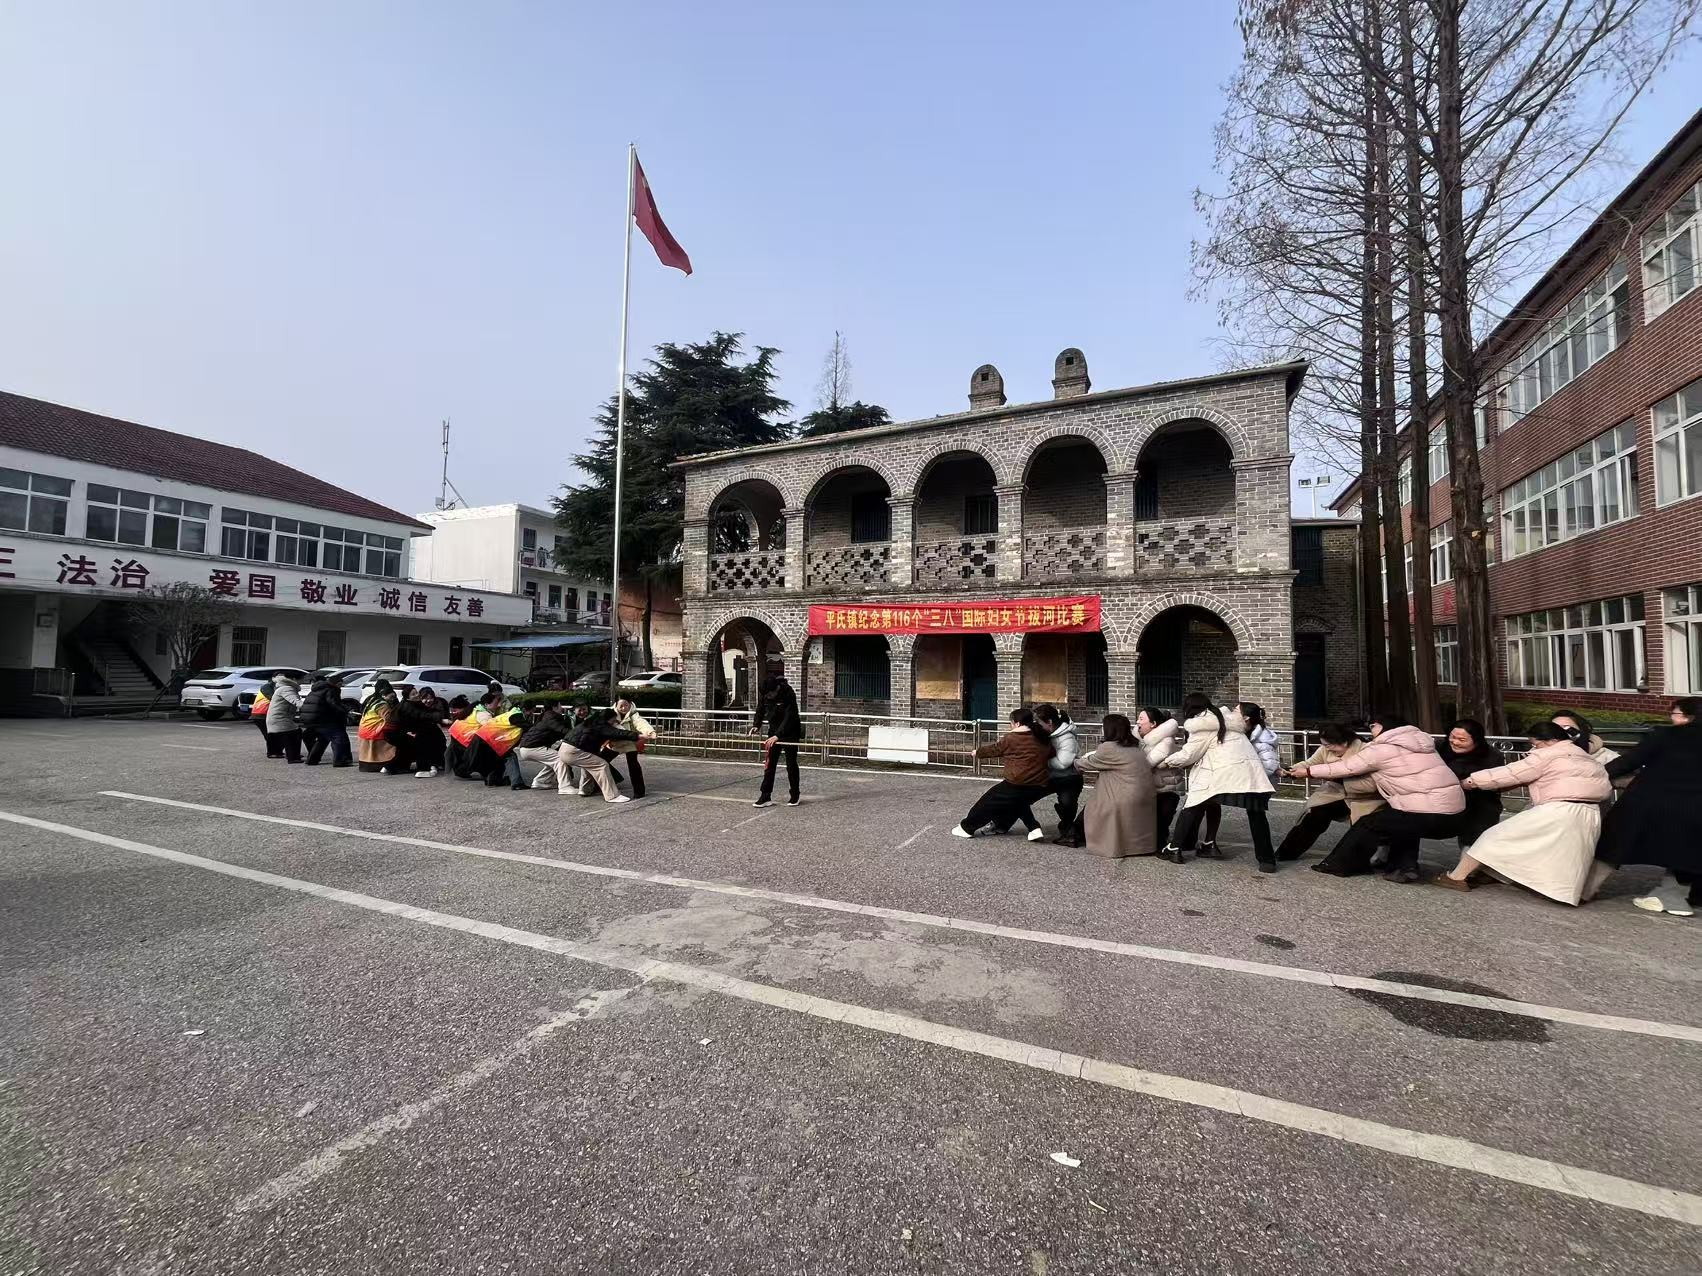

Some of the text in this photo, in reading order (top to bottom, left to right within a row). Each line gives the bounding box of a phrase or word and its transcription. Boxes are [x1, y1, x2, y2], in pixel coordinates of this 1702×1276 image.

[56, 553, 484, 617] 法治 爱国 敬业 诚信 友善
